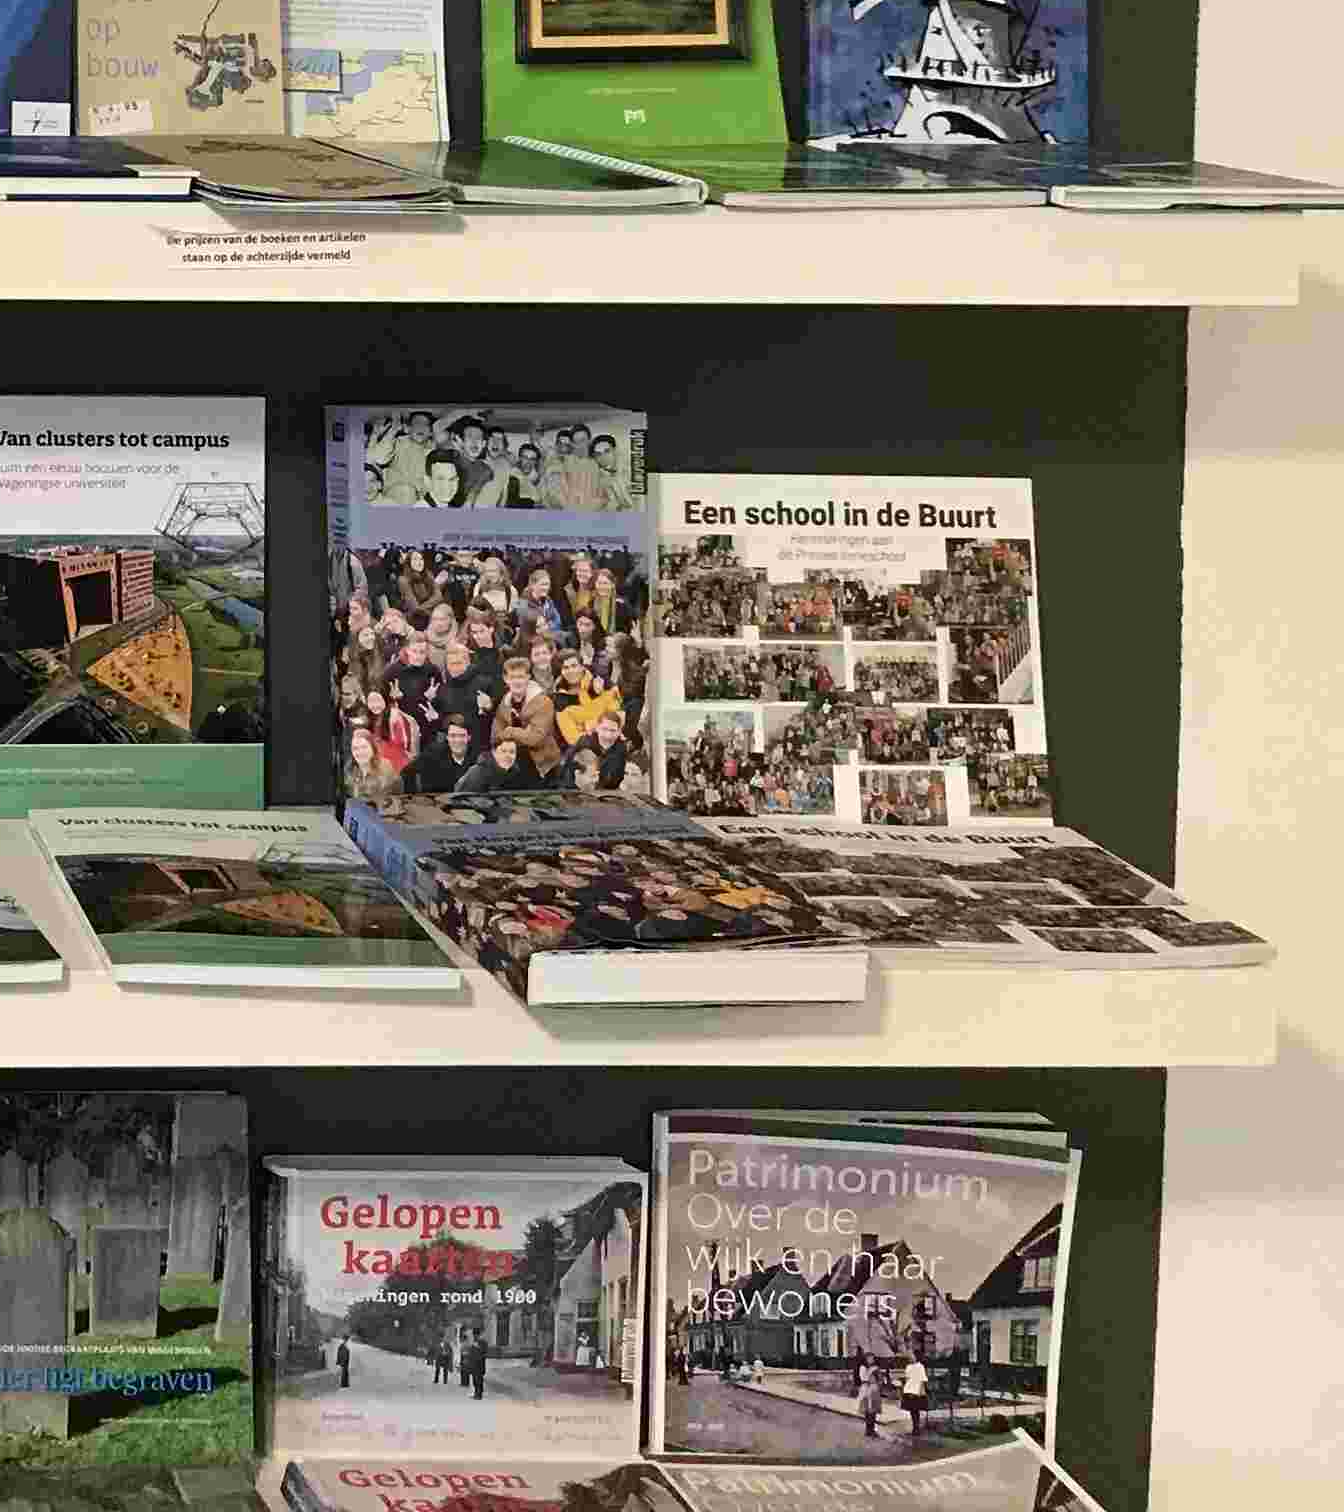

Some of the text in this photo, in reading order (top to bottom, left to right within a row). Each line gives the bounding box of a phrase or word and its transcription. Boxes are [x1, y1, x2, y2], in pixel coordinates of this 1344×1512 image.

[223, 236, 242, 244] van
[244, 233, 259, 244] de
[262, 232, 301, 243] boeken
[303, 234, 317, 243] en
[319, 232, 366, 242] artikelen
[214, 253, 227, 264] op
[230, 251, 243, 261] de
[246, 250, 305, 263] achterzijde
[307, 250, 351, 260] vermeld
[36, 430, 114, 448] clusters
[119, 432, 149, 448] tot
[153, 433, 229, 451] campus
[684, 501, 997, 528] Een school in de Buurt
[689, 1148, 988, 1200] Patrimonium
[321, 1193, 502, 1239] Gelopen
[686, 1193, 858, 1234] Over de
[686, 1237, 944, 1281] wijk en haar
[440, 1289, 536, 1304] rond 1900
[687, 1280, 897, 1321] bewoners
